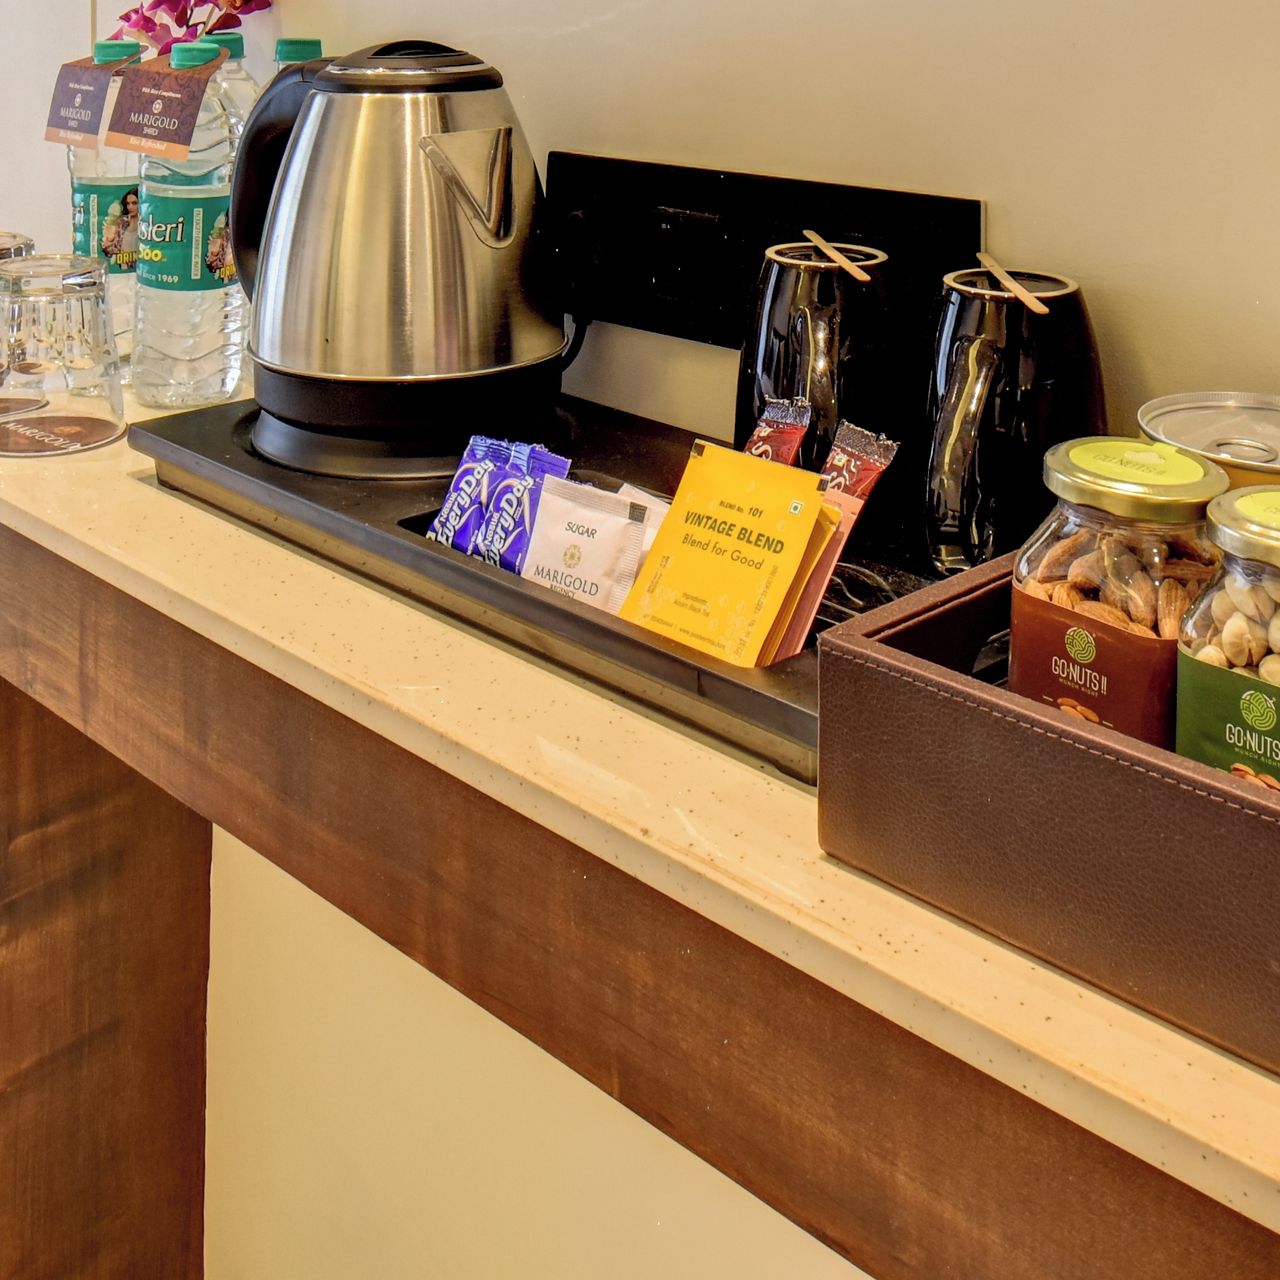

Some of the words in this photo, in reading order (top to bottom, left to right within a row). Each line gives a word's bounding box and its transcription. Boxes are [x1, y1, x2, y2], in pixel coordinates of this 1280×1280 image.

[61, 107, 91, 121] MARIGOLD
[129, 112, 178, 130] MARIGOLD
[158, 273, 179, 284] 1969
[748, 506, 764, 518] 101
[565, 521, 597, 539] SUGAR
[684, 510, 736, 537] VINTAGE
[736, 527, 785, 555] BLEND
[682, 533, 710, 551] Blend
[712, 539, 727, 557] for
[730, 549, 765, 570] Good
[534, 564, 599, 596] MARIGOLD
[1234, 747, 1258, 759] MUNCH
